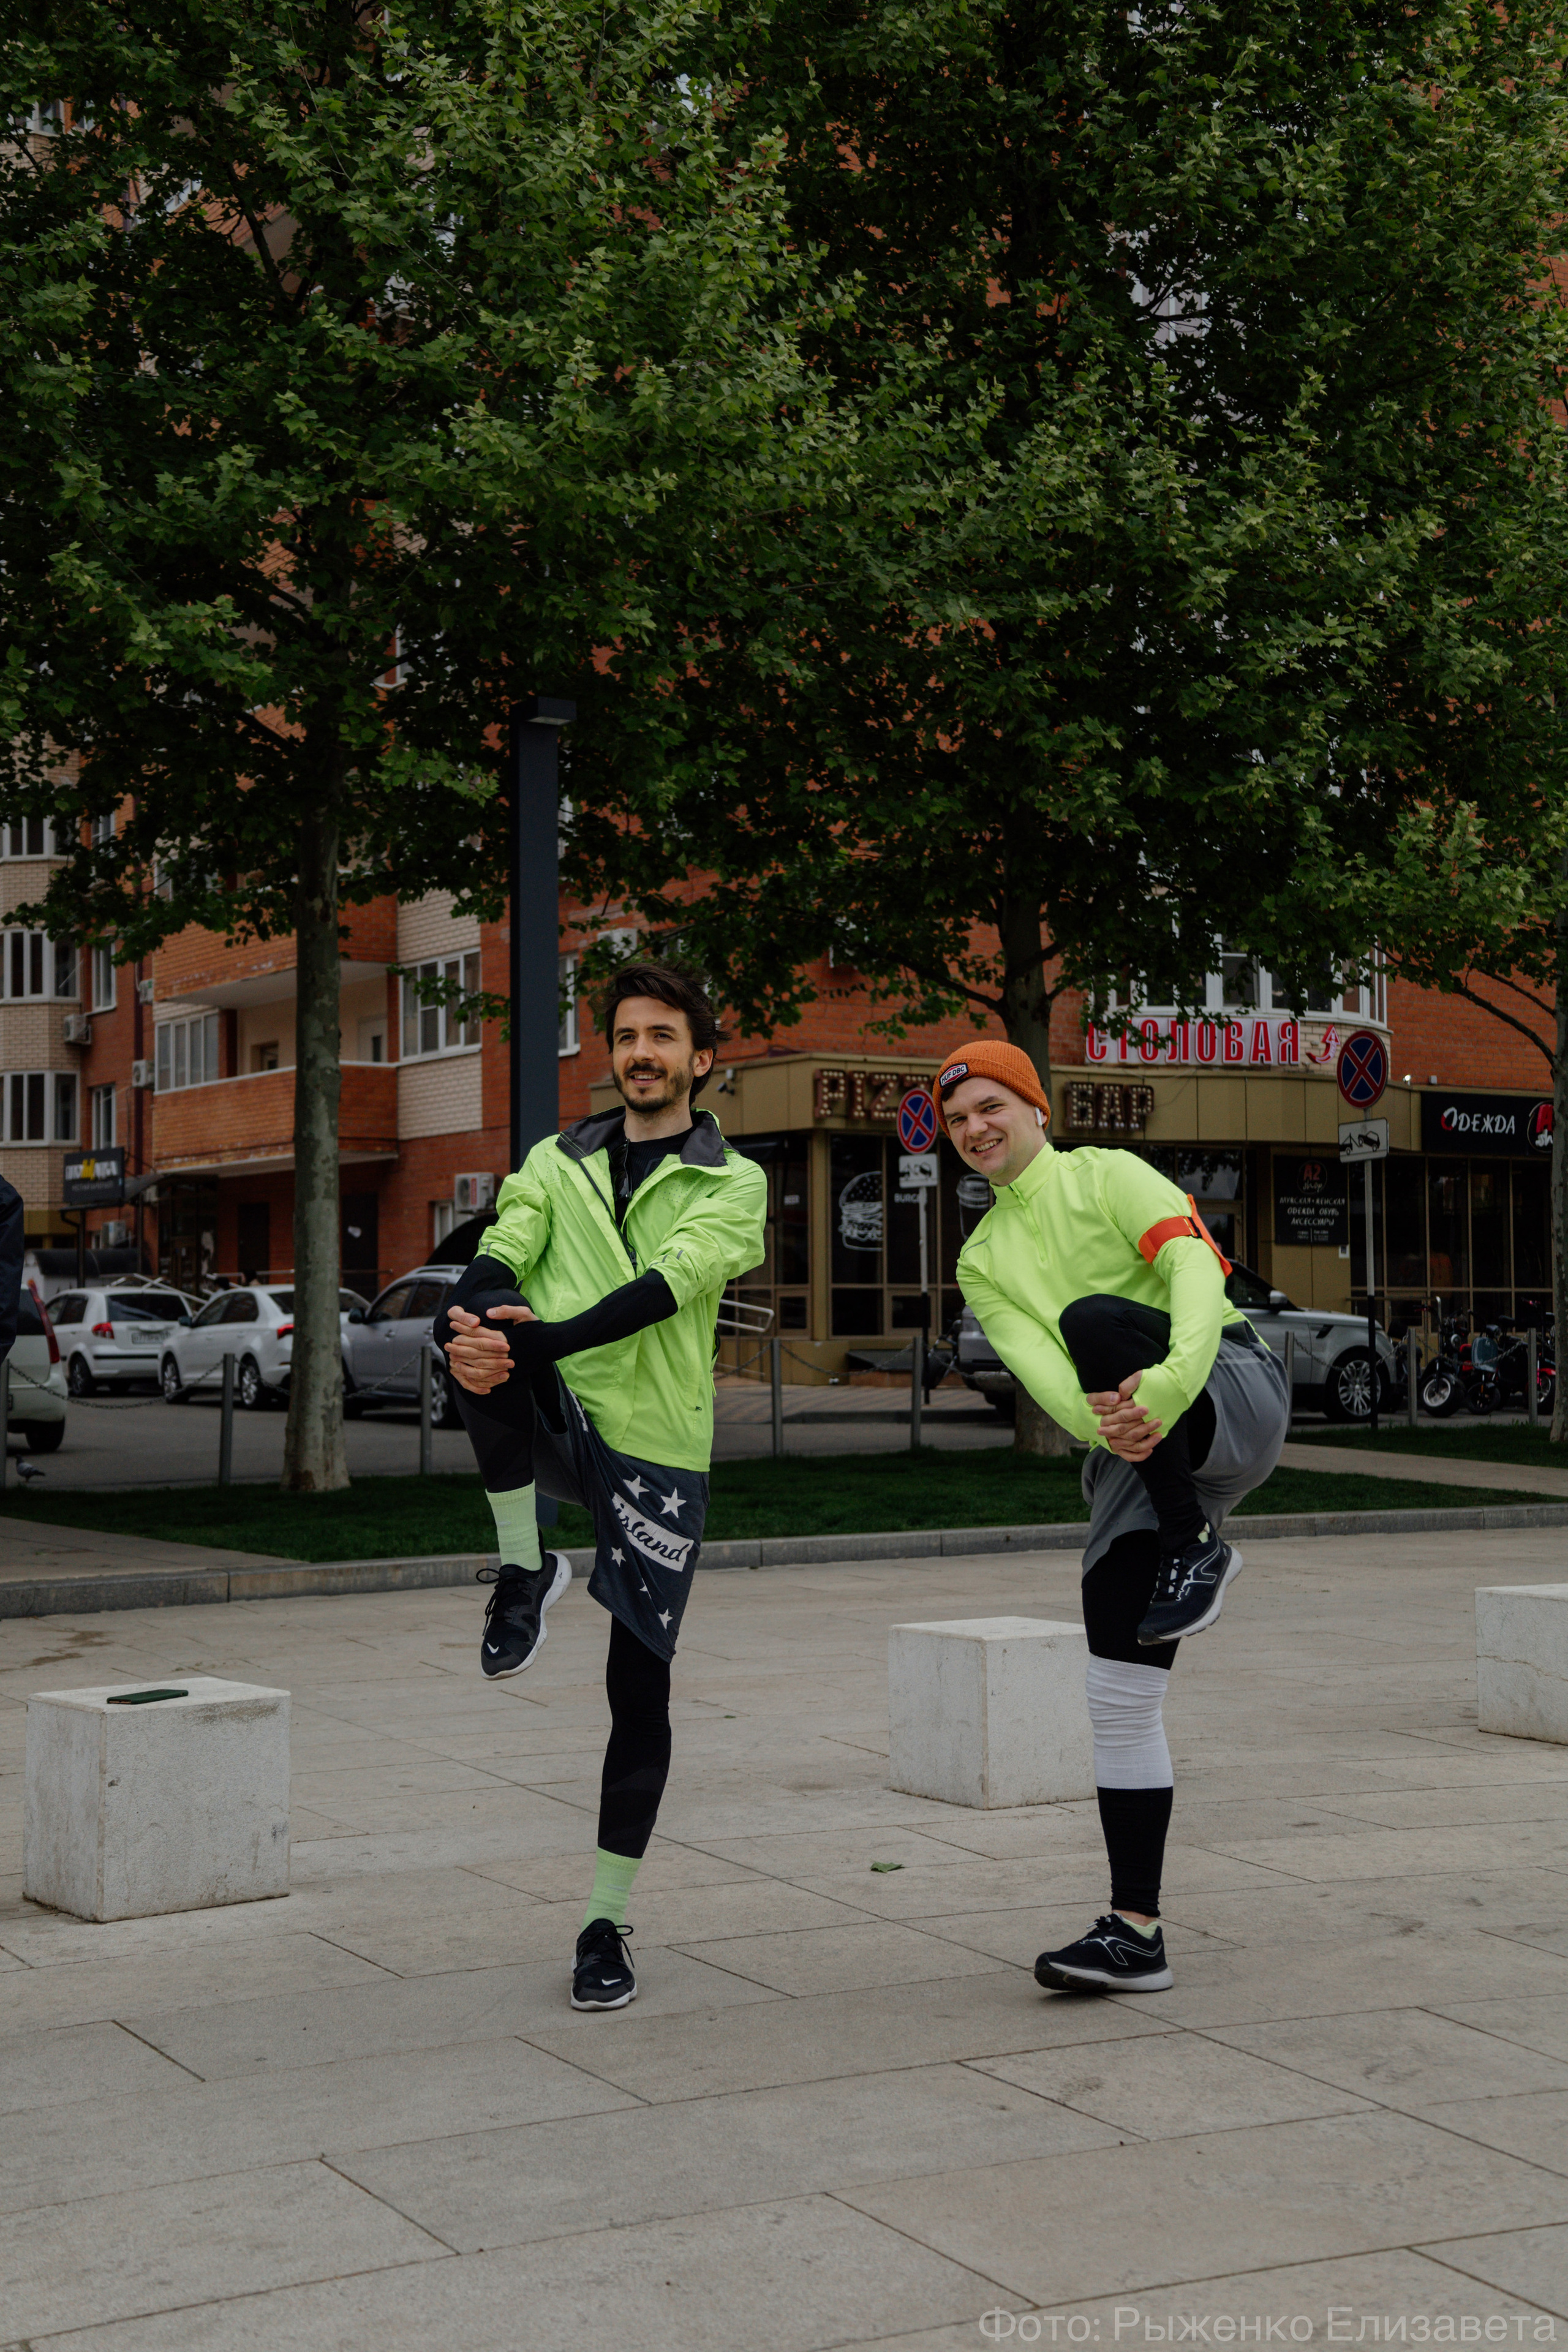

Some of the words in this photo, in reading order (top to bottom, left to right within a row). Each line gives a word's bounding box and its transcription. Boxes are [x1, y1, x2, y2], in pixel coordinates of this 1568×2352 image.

[1087, 1019, 1300, 1065] СТОЛОВАЯ
[941, 1071, 952, 1084] HUF
[952, 1066, 965, 1076] DBC
[1065, 1081, 1154, 1128] БАР
[1441, 1106, 1515, 1135] ОДЕЖДА
[1303, 1163, 1322, 1181] A2
[1302, 1180, 1323, 1194] shop
[894, 1193, 922, 1204] BURG
[1287, 1207, 1315, 1215] ОДЕЖДА
[1319, 1207, 1340, 1216] ОБУВЬ
[1291, 1216, 1335, 1226] АКСЕССУАРЫ
